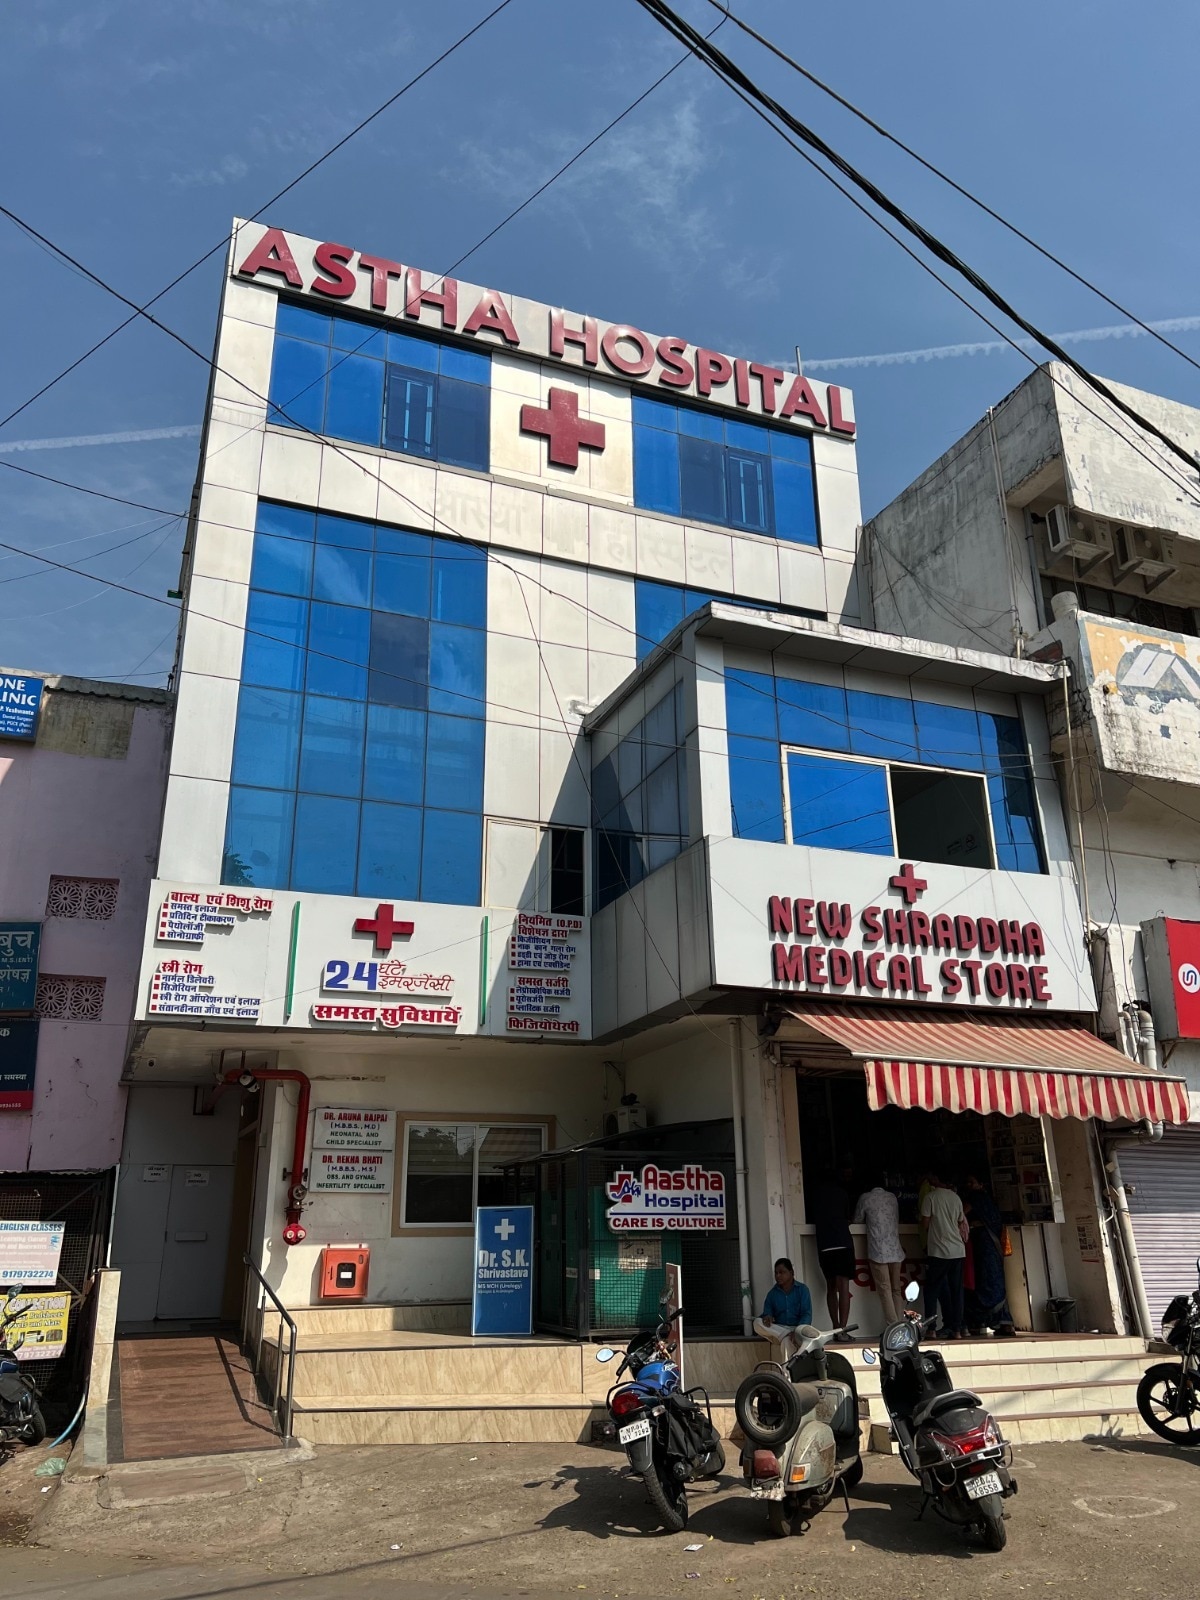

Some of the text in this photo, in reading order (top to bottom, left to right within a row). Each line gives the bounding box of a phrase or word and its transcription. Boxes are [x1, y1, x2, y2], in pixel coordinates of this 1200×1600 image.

[238, 227, 856, 436] ASTHA HOSPITAL
[0, 692, 37, 706] INIC
[171, 892, 273, 910] बाल्य एवं शिशु रोग
[170, 903, 217, 913] समस्त इलाज
[169, 911, 235, 923] प्रतिदिन टीकाकरण
[518, 913, 552, 926] नियमित
[518, 924, 549, 937] विशेषज्ञ
[768, 895, 1045, 956] NEW SHRADDHA
[167, 930, 204, 940] सोनोग्राफी
[565, 945, 576, 953] रोग
[161, 960, 203, 974] स्त्री रोग
[378, 960, 406, 976] घंटे
[772, 943, 1052, 1001] MEDICAL STORE
[325, 960, 378, 990] 24
[518, 976, 569, 987] समस्त सर्जरी
[378, 974, 454, 991] इमरजेंसी
[554, 988, 571, 996] सर्जरी
[160, 992, 172, 1001] स्त्री
[174, 993, 187, 1002] रोग
[225, 995, 237, 1004] एवं
[238, 998, 261, 1006] इलाज
[236, 1008, 259, 1017] इलाज
[543, 1004, 560, 1013] सर्जरी
[315, 1005, 462, 1026] समस्त सुविधायें
[324, 1112, 387, 1122] DR. ARUNA BAJPAI
[322, 1155, 383, 1164] DR. REKHA BHATI
[644, 1166, 723, 1190] Aastha
[645, 1193, 723, 1211] Hospital
[0, 1223, 63, 1232] ENGLISH CLASSES
[613, 1218, 725, 1228] CARE IS CULTURE
[479, 1249, 529, 1267] Dr. S.K.
[2, 1270, 54, 1278] 9179732274
[478, 1268, 528, 1278] Shrivastava
